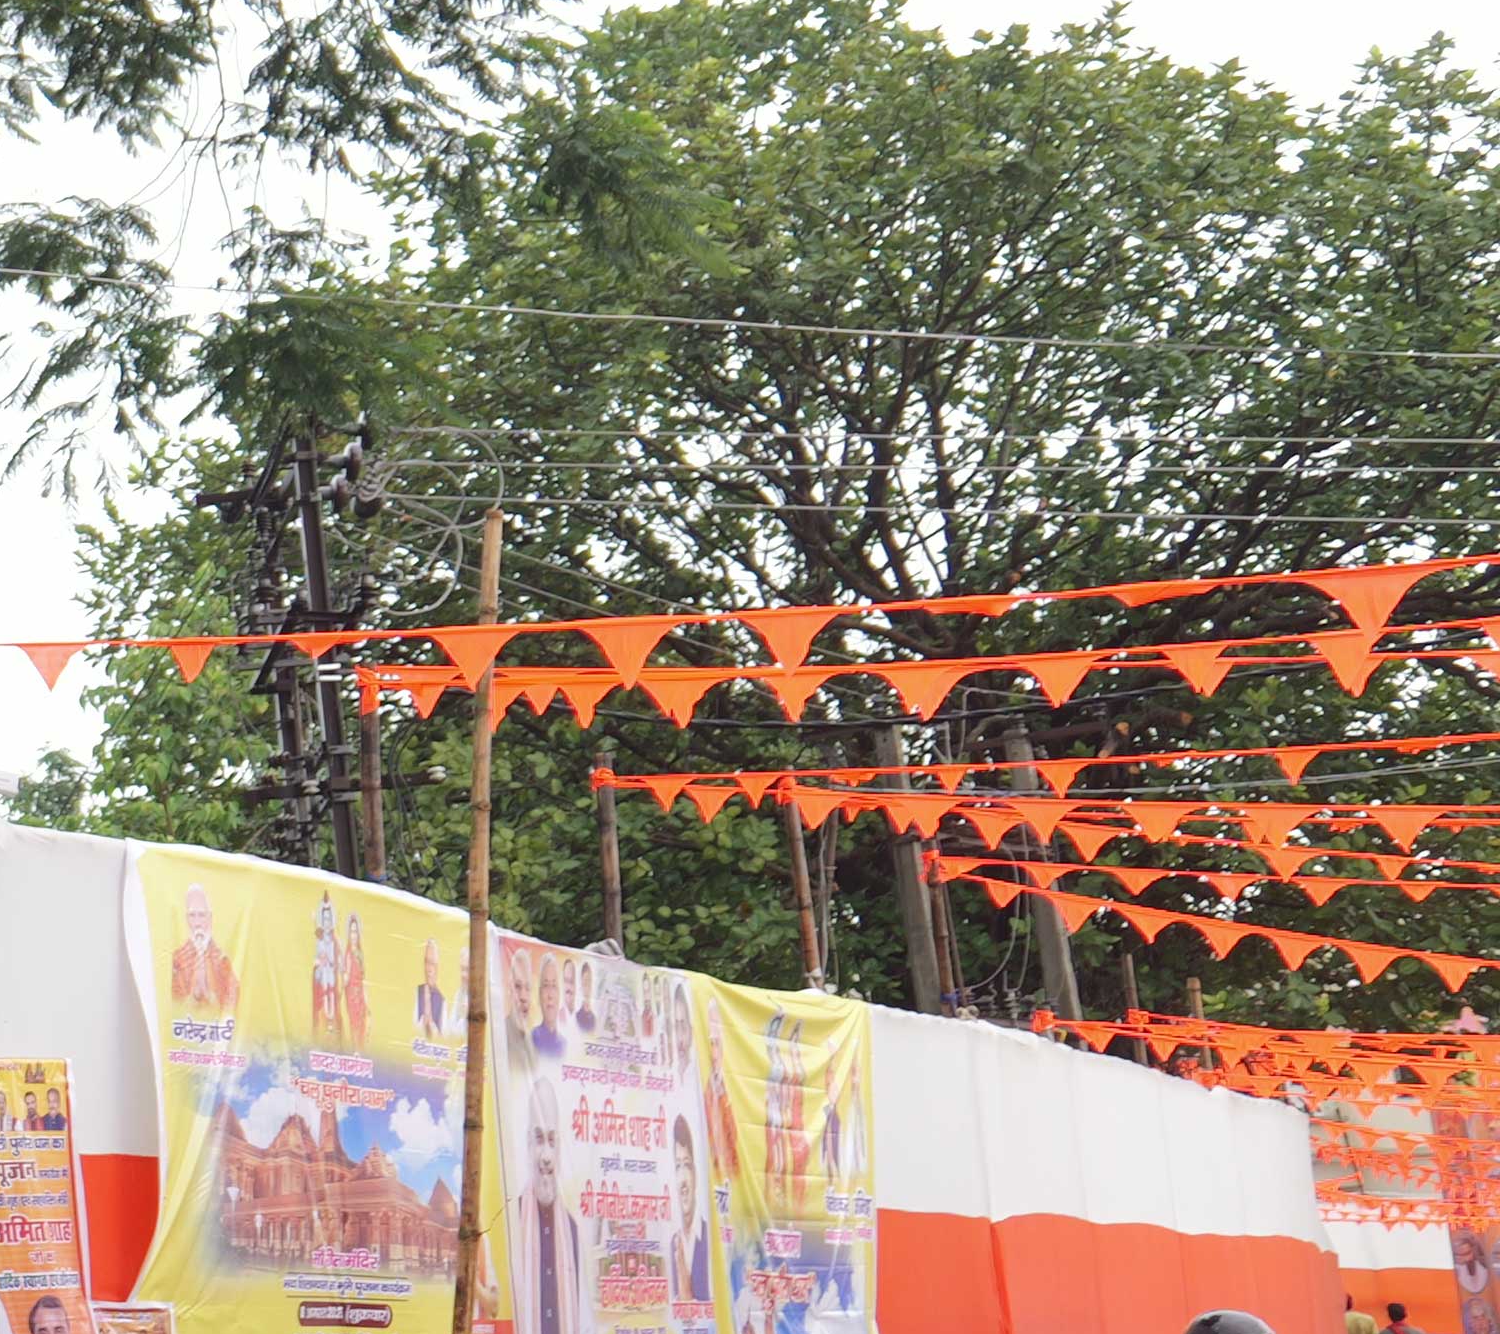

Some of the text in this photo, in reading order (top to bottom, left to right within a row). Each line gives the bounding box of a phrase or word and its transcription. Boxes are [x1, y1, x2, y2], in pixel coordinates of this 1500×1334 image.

[572, 1094, 668, 1151] श्री अमित शाह जी
